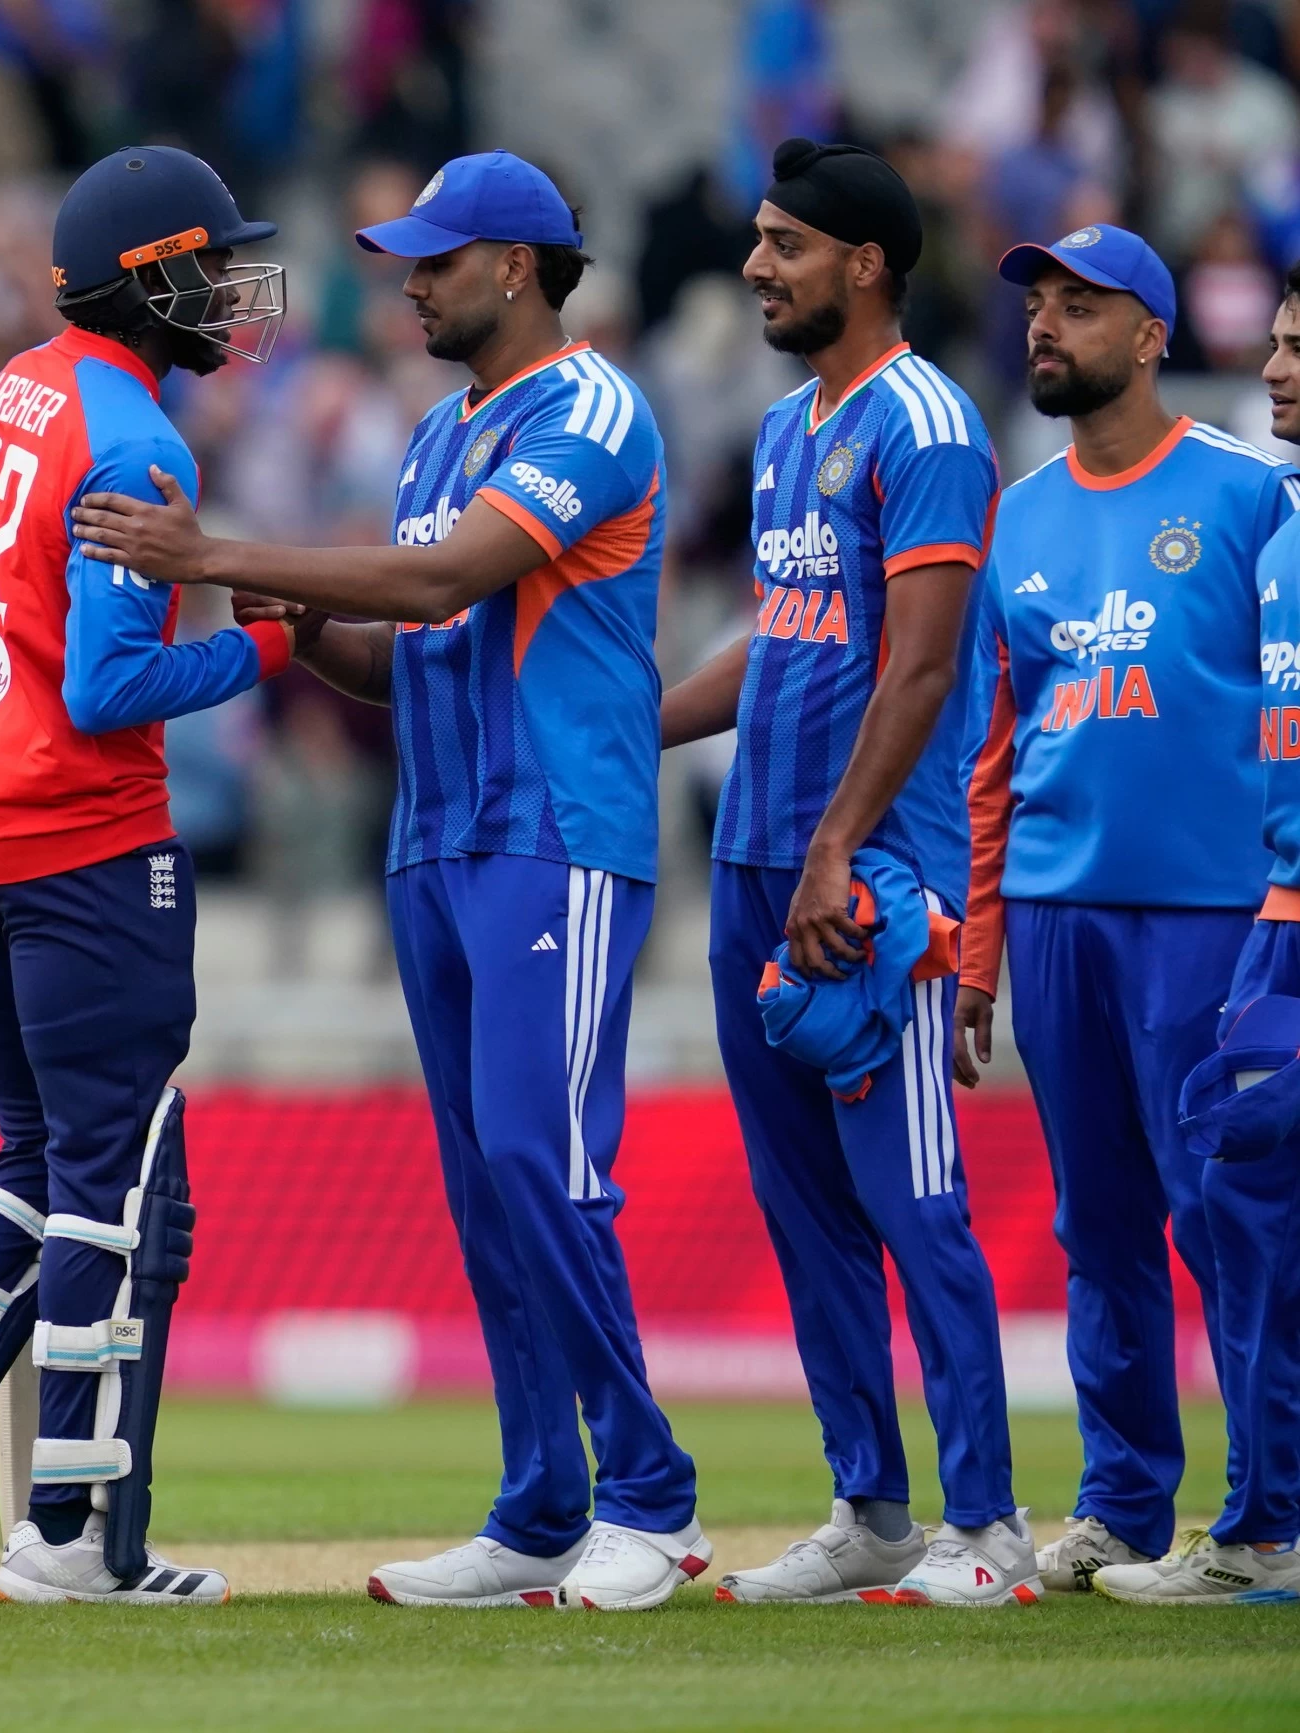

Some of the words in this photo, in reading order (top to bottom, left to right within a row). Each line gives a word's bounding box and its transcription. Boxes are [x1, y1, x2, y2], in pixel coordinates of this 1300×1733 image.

[155, 239, 182, 256] DSC
[51, 266, 67, 288] SC
[510, 462, 582, 516] apollo
[524, 484, 574, 523] TYRES
[757, 511, 838, 573] apollo
[781, 555, 840, 579] TYRES
[755, 585, 849, 645] NDIA
[1088, 631, 1151, 665] TRES
[115, 1326, 137, 1337] DSC
[1204, 1567, 1254, 1585] LOTTO
